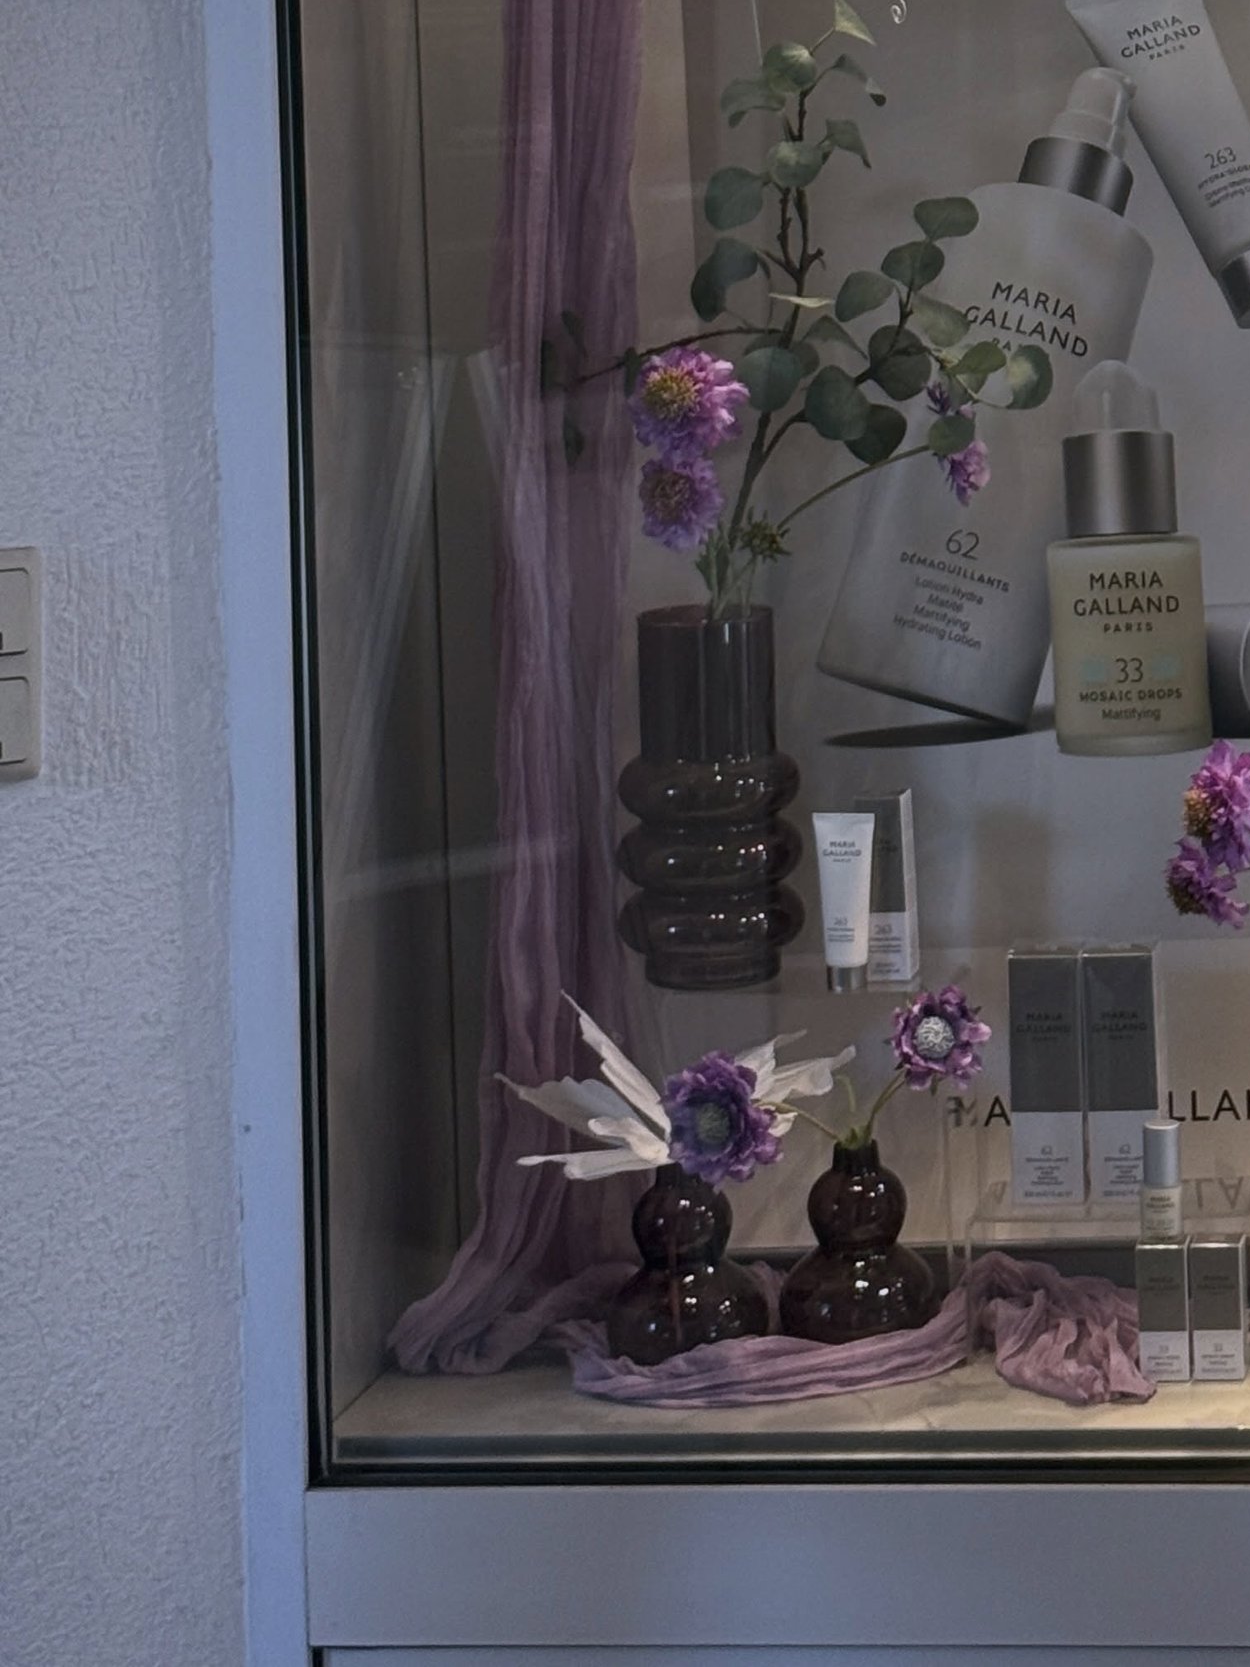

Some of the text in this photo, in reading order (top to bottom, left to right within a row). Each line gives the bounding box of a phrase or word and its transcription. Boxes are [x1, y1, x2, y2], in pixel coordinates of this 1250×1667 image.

[1121, 24, 1201, 58] GALLAND
[1126, 15, 1183, 41] MARIA
[1204, 146, 1237, 170] 263
[991, 282, 1077, 325] MARIA
[964, 305, 1089, 358] GALLAND
[946, 529, 980, 561] 62
[900, 551, 1011, 593] DÉMAQUILLANTS
[1089, 571, 1164, 591] MARIA
[1073, 595, 1180, 617] GALLAND
[1104, 622, 1153, 633] PARIS
[1115, 657, 1144, 684] 33
[1079, 688, 1183, 703] MOSAIC DROPS
[1102, 707, 1162, 721] Mattifying
